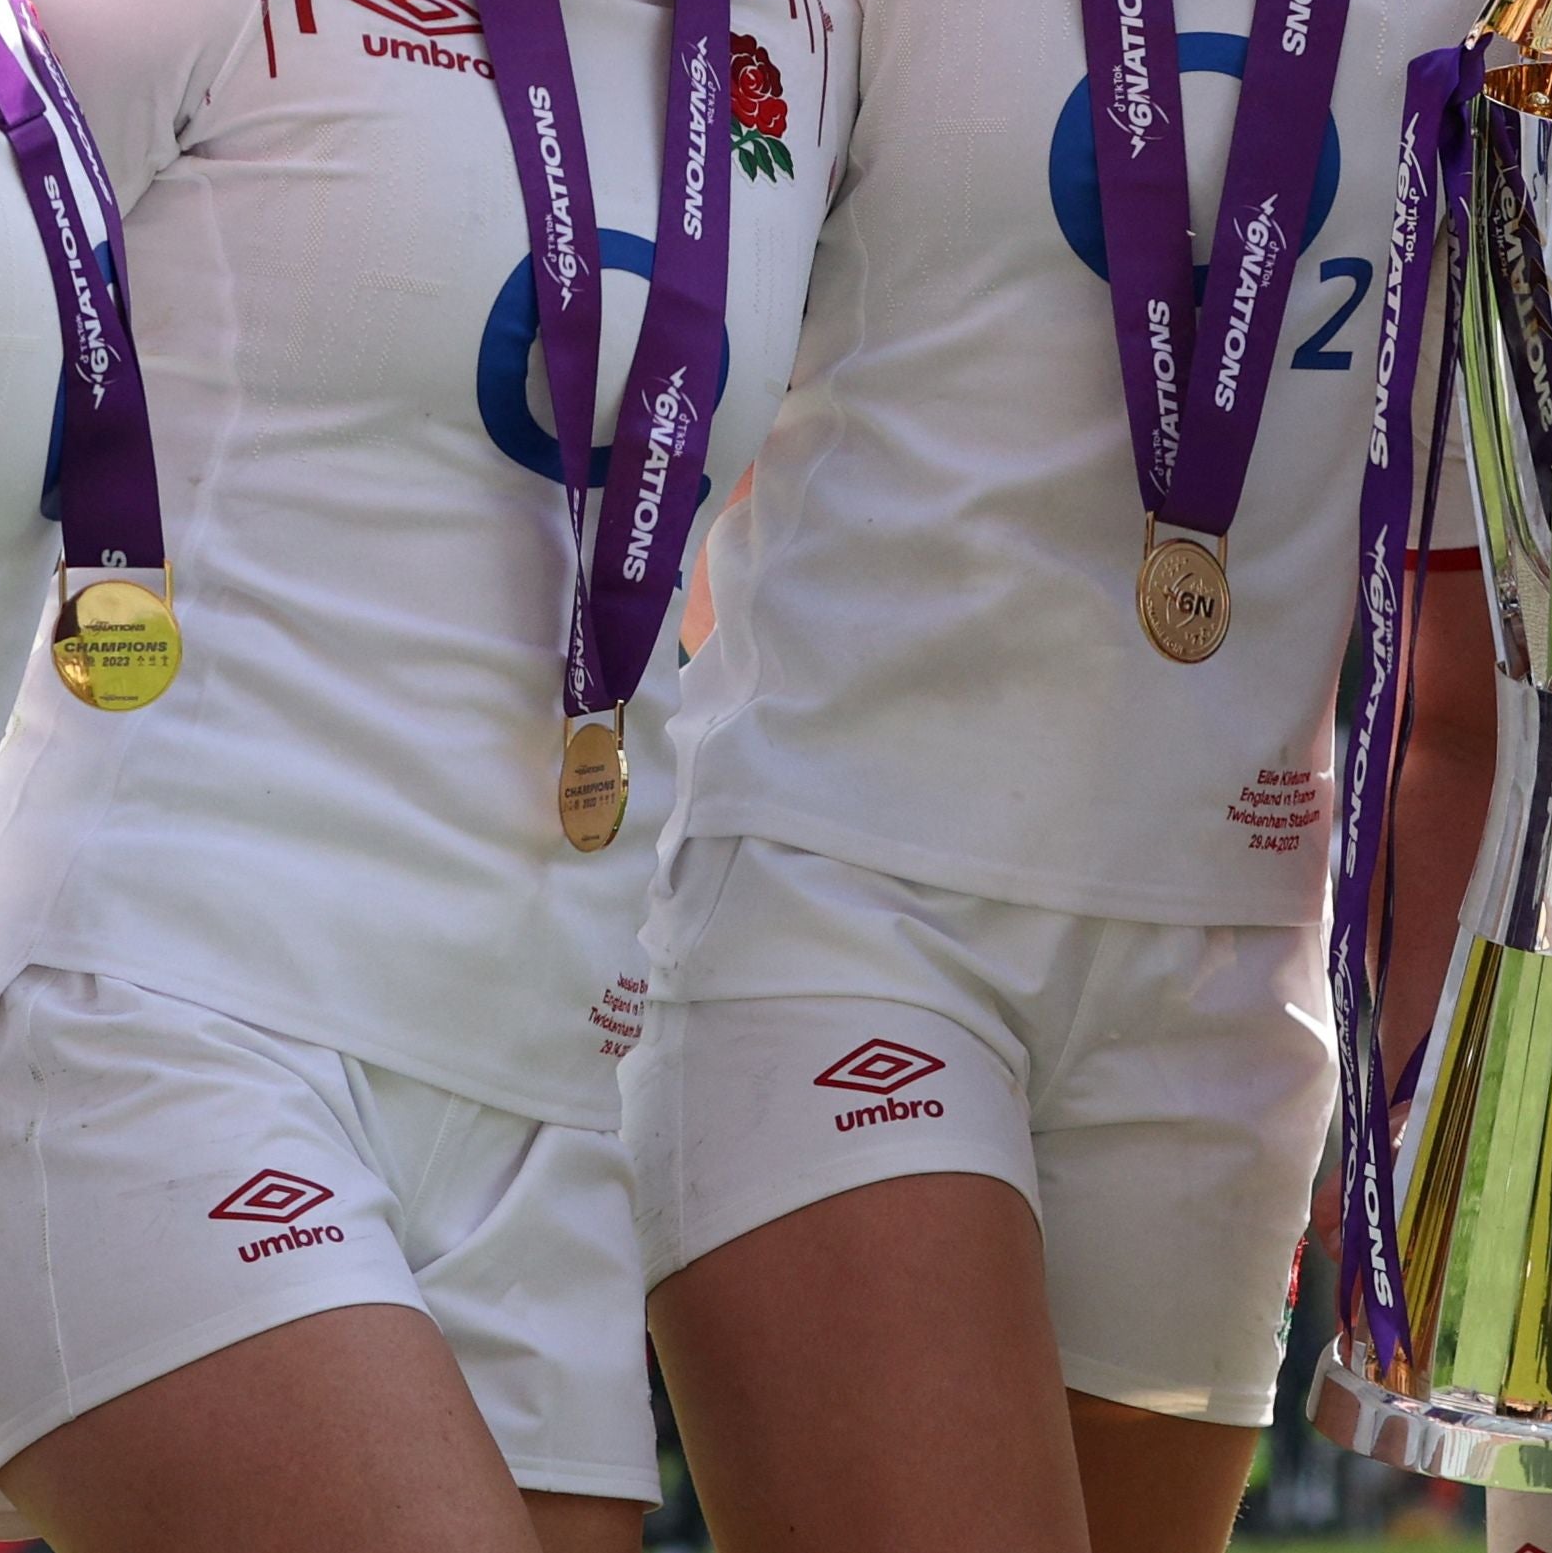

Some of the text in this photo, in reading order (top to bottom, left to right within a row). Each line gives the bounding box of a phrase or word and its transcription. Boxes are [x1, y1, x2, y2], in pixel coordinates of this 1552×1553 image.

[528, 85, 579, 292] 6NATIONS
[683, 59, 709, 240] 6NATIONS
[1215, 220, 1271, 413] 6NATIONS
[1369, 170, 1417, 470] 6NATIONS
[622, 388, 681, 584] 6NATIONS
[63, 641, 168, 653] CHAMPIONS
[102, 656, 131, 667] 2023
[1345, 578, 1387, 879] 6NATIONS
[1226, 805, 1287, 829] Twickenham
[1240, 787, 1280, 808] England
[834, 1097, 945, 1133] umbro
[237, 1225, 345, 1263] umbro
